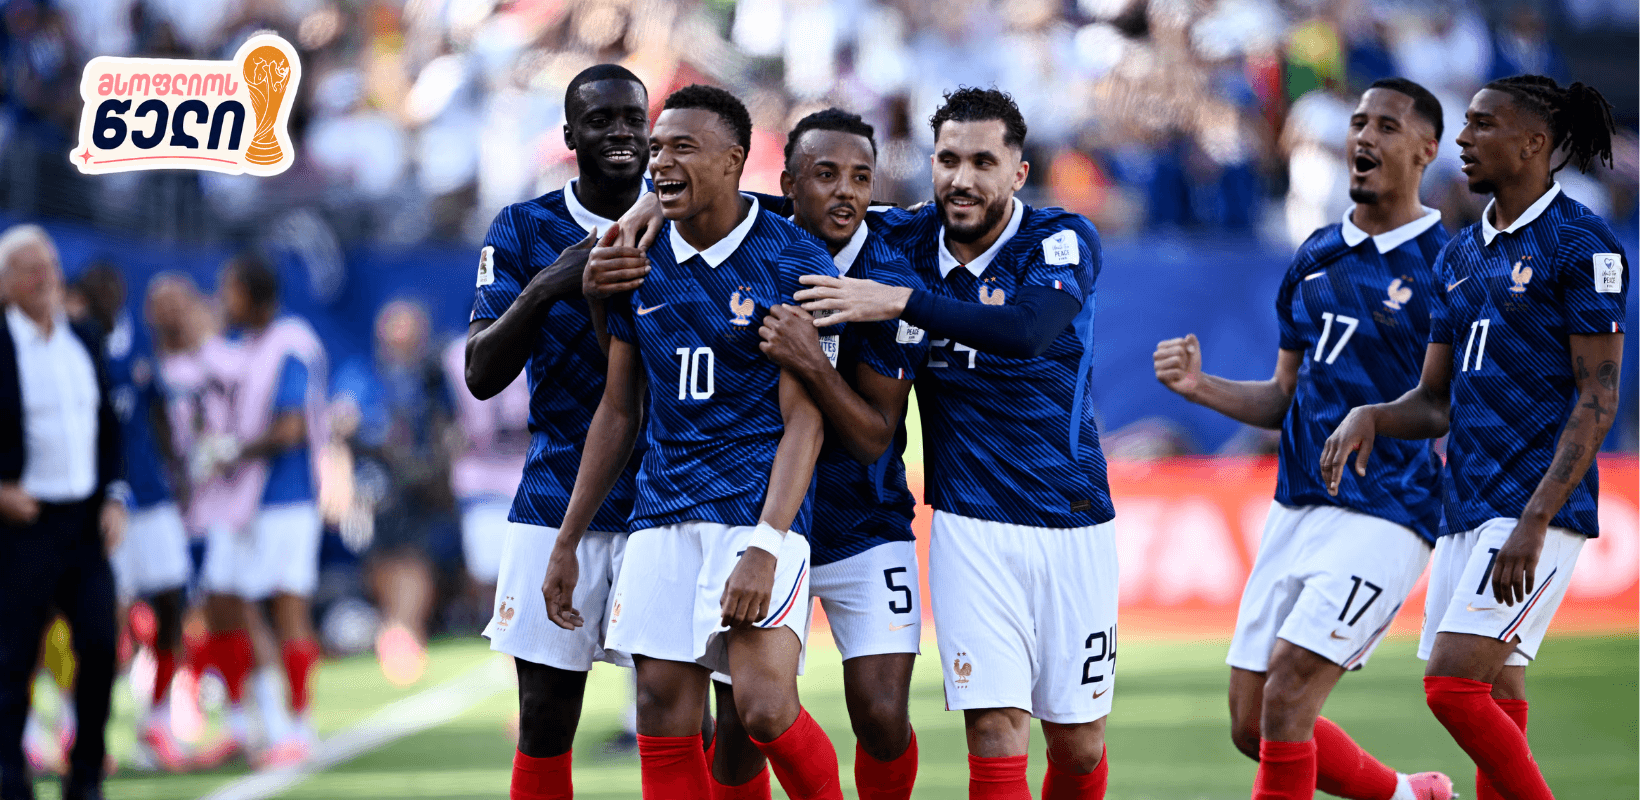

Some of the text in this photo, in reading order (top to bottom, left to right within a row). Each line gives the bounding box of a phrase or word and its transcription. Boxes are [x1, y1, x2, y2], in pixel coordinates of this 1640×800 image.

[1313, 312, 1359, 365] 17
[1462, 319, 1491, 372] 11
[676, 347, 715, 400] 10
[883, 566, 912, 614] 5
[1475, 547, 1500, 596] 1
[1337, 575, 1383, 627] 17
[1080, 623, 1117, 685] 24
